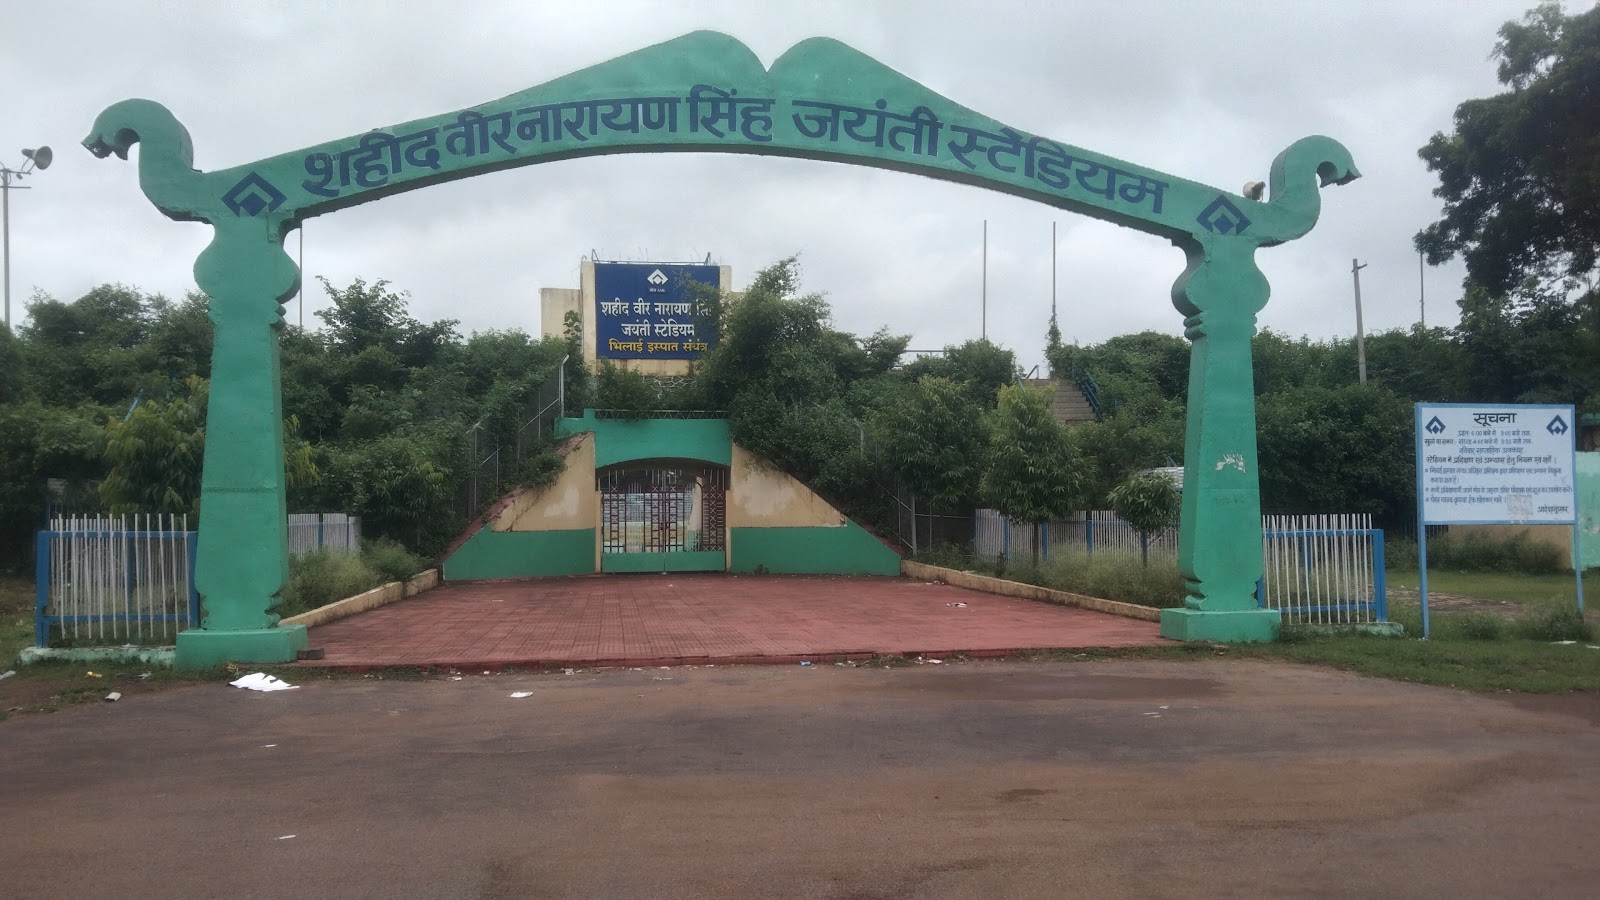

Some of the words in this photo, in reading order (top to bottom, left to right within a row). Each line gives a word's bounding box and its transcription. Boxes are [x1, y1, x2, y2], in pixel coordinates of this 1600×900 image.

[301, 127, 441, 196] शहीद
[442, 110, 519, 158] वीर
[516, 97, 681, 143] नारायण
[686, 84, 776, 142] सिंह
[792, 98, 944, 157] जयंती
[947, 123, 1170, 214] स्टेडियम
[600, 297, 629, 317] शहीद
[633, 297, 651, 316] वीर
[654, 302, 692, 316] नारायण
[621, 319, 651, 337] जयंती
[654, 318, 695, 337] स्टेडियम
[608, 338, 643, 354] भिलाई
[647, 341, 679, 354] इस्पात
[1473, 412, 1518, 427] सूचना
